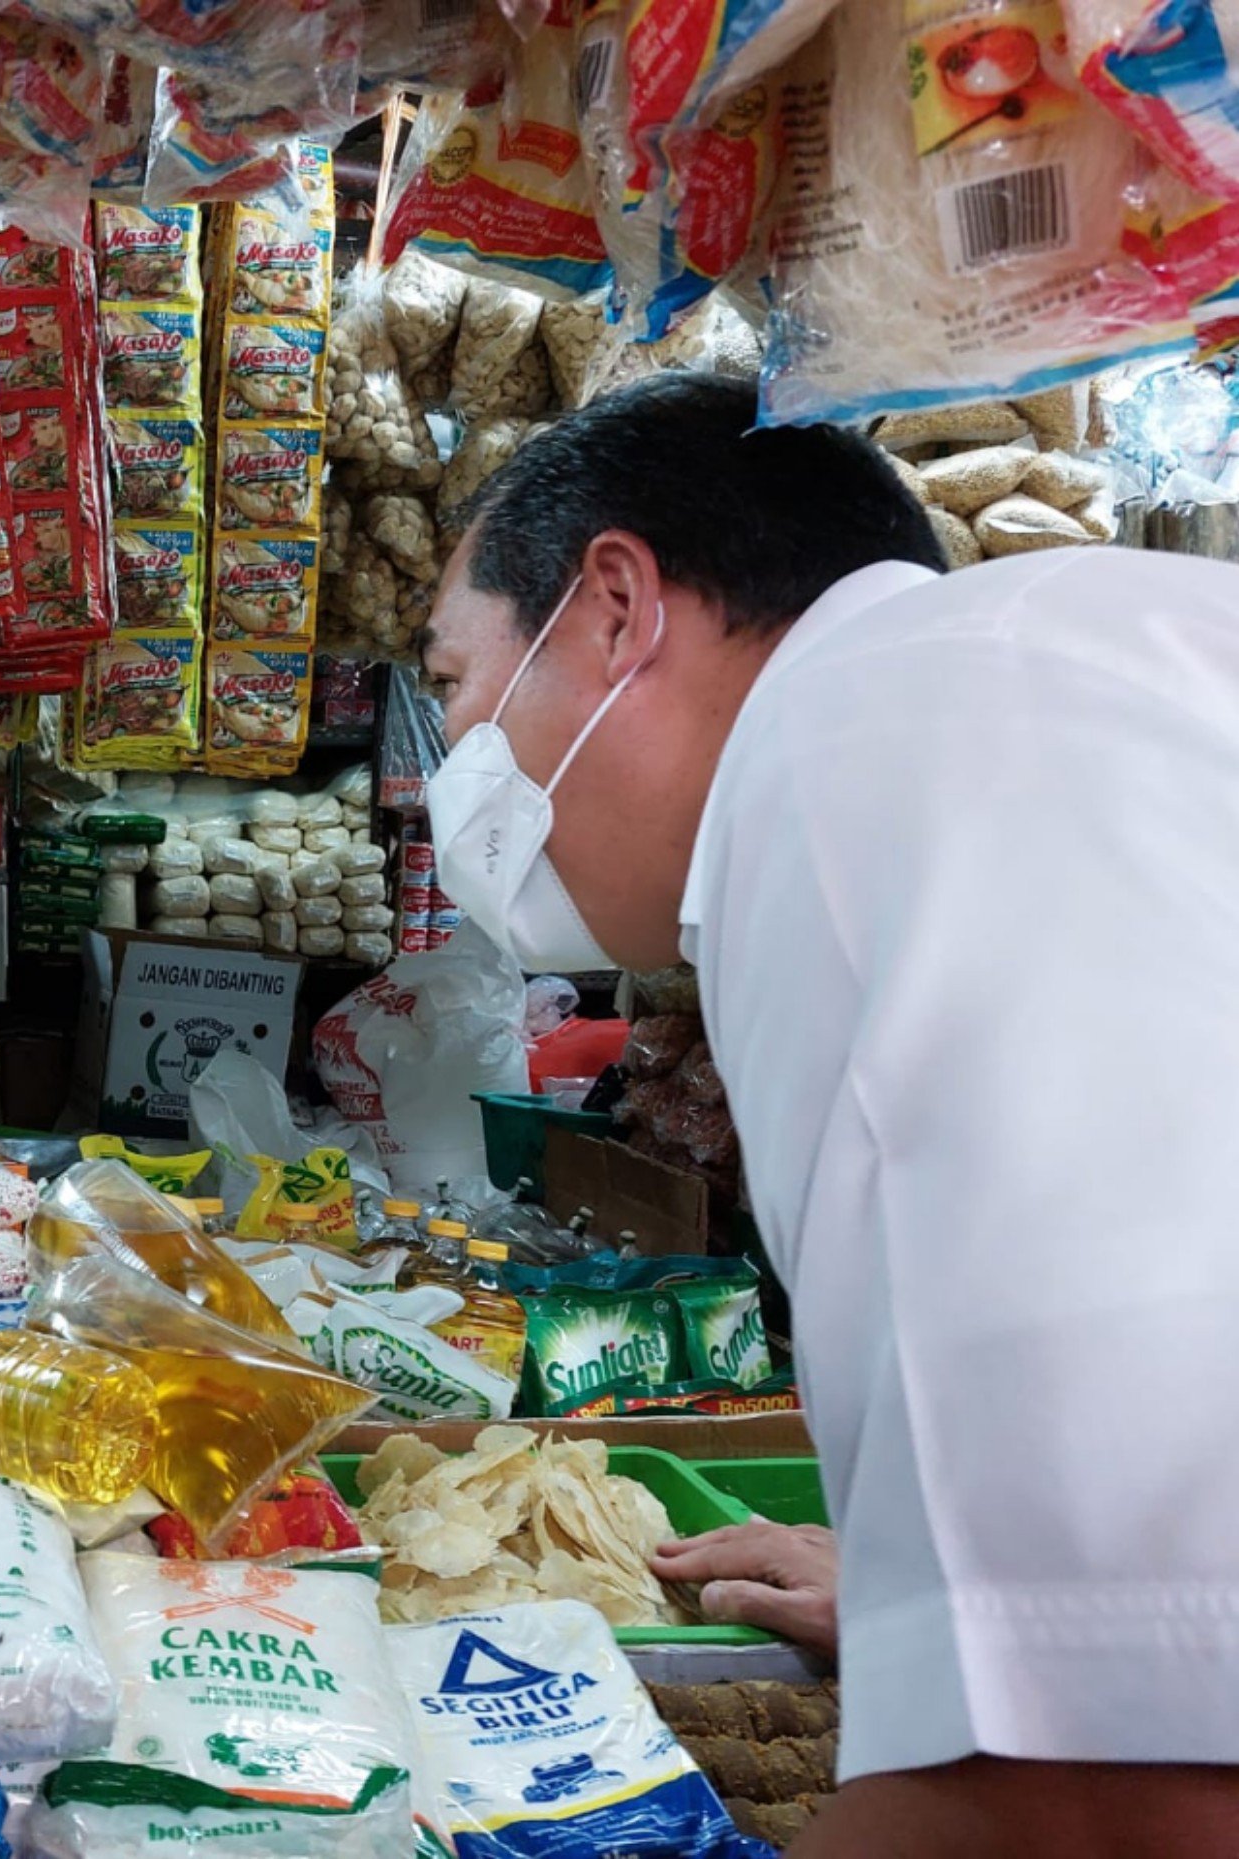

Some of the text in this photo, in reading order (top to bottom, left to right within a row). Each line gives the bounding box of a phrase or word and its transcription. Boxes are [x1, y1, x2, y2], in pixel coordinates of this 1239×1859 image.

[101, 224, 181, 247] Masako
[237, 244, 318, 265] Masako
[103, 333, 181, 354] Masako
[229, 347, 310, 368] Masako
[223, 451, 306, 477] Masako
[218, 561, 300, 587] Masako
[101, 657, 179, 685] Masako
[214, 670, 294, 696] Masako
[138, 962, 285, 995] JANGAN DIBANTING
[360, 1343, 462, 1410] Sania
[546, 1333, 668, 1400] Sunlight
[161, 1626, 319, 1664] CAKRA
[150, 1655, 340, 1694] KEMBAR
[420, 1672, 600, 1716] SEGITIGA
[474, 1703, 572, 1731] BIRU
